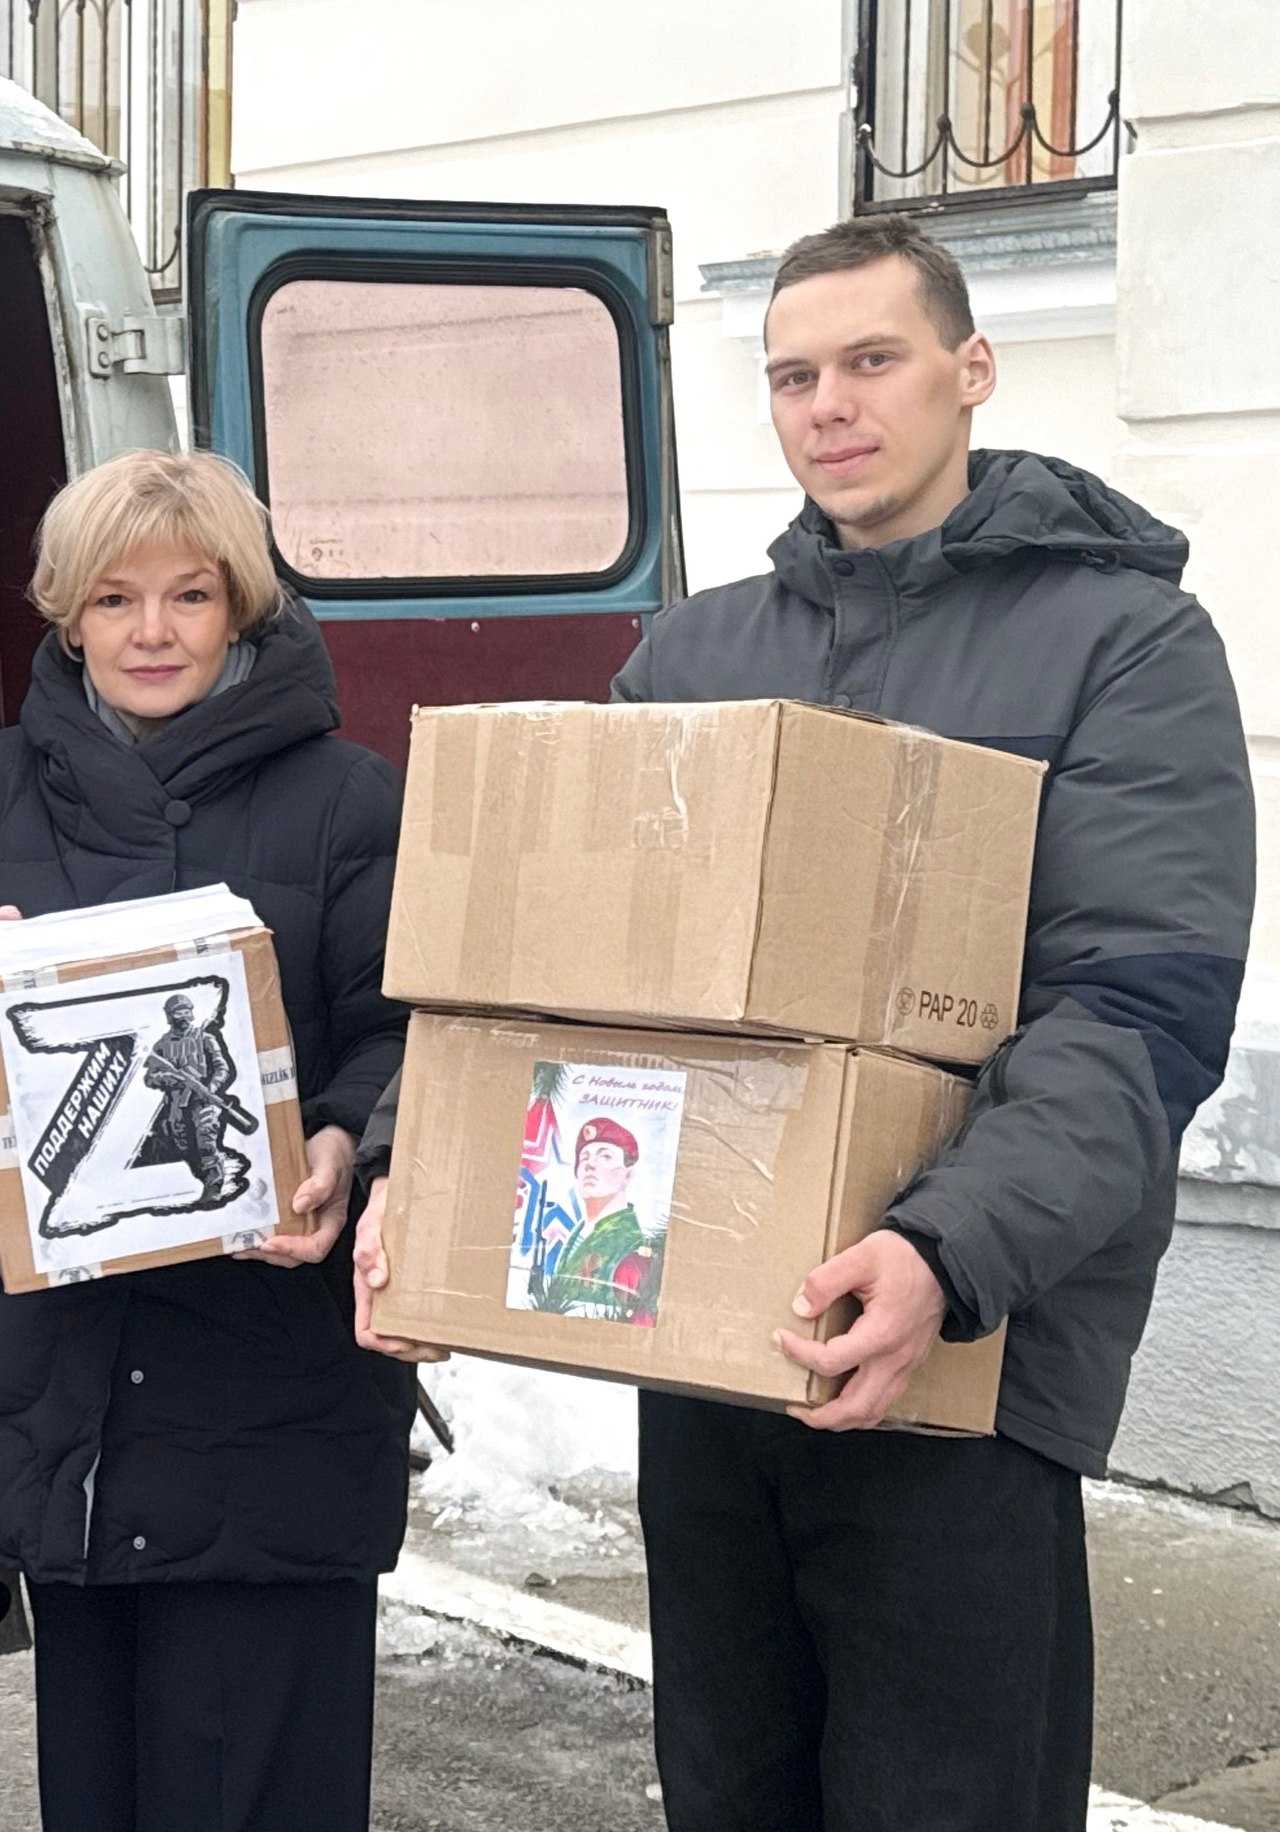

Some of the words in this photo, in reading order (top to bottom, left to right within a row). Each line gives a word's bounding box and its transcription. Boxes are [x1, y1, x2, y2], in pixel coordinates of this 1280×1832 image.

[919, 990, 954, 1022] PAP
[956, 998, 978, 1028] 20
[78, 1050, 128, 1140] НАШИХ!
[572, 1074, 586, 1085] С
[589, 1076, 637, 1090] Новым
[33, 1041, 111, 1177] ПОДДЕРЖИМ
[579, 1093, 680, 1112] ЗАЩИТНИК!
